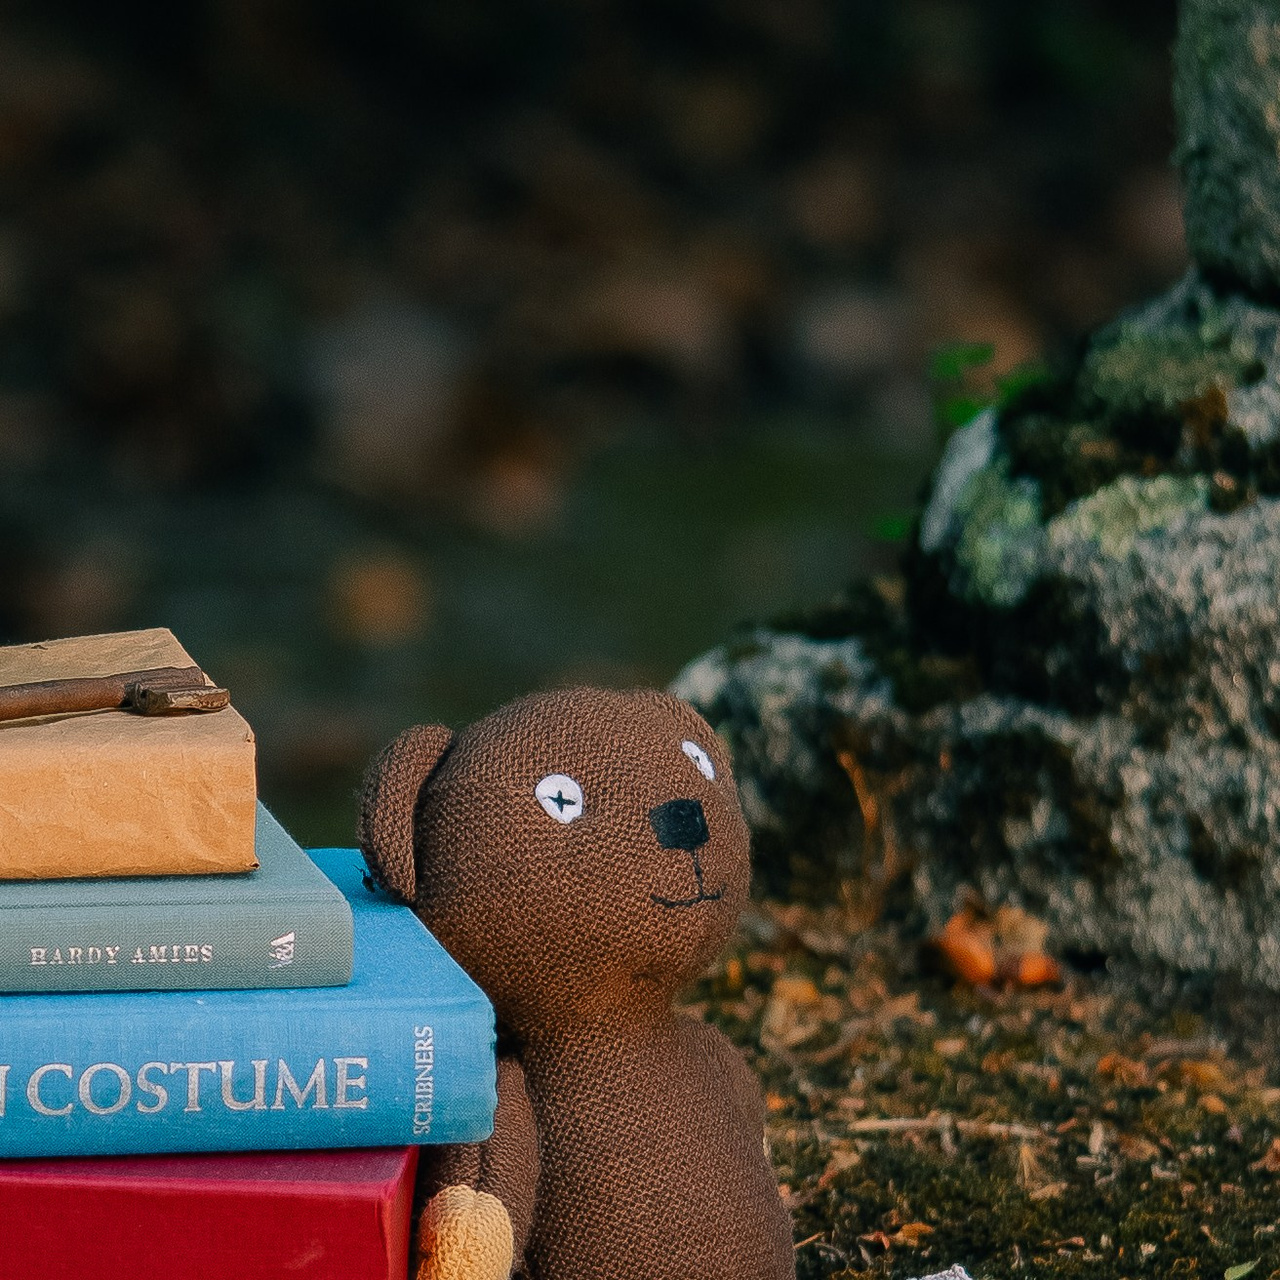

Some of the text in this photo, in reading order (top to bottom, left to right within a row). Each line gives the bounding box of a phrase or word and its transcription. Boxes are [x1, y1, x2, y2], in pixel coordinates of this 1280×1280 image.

[29, 943, 214, 967] HARDY AMIES
[26, 1056, 370, 1118] COSTUME
[412, 1025, 434, 1135] SCRIBNERS
